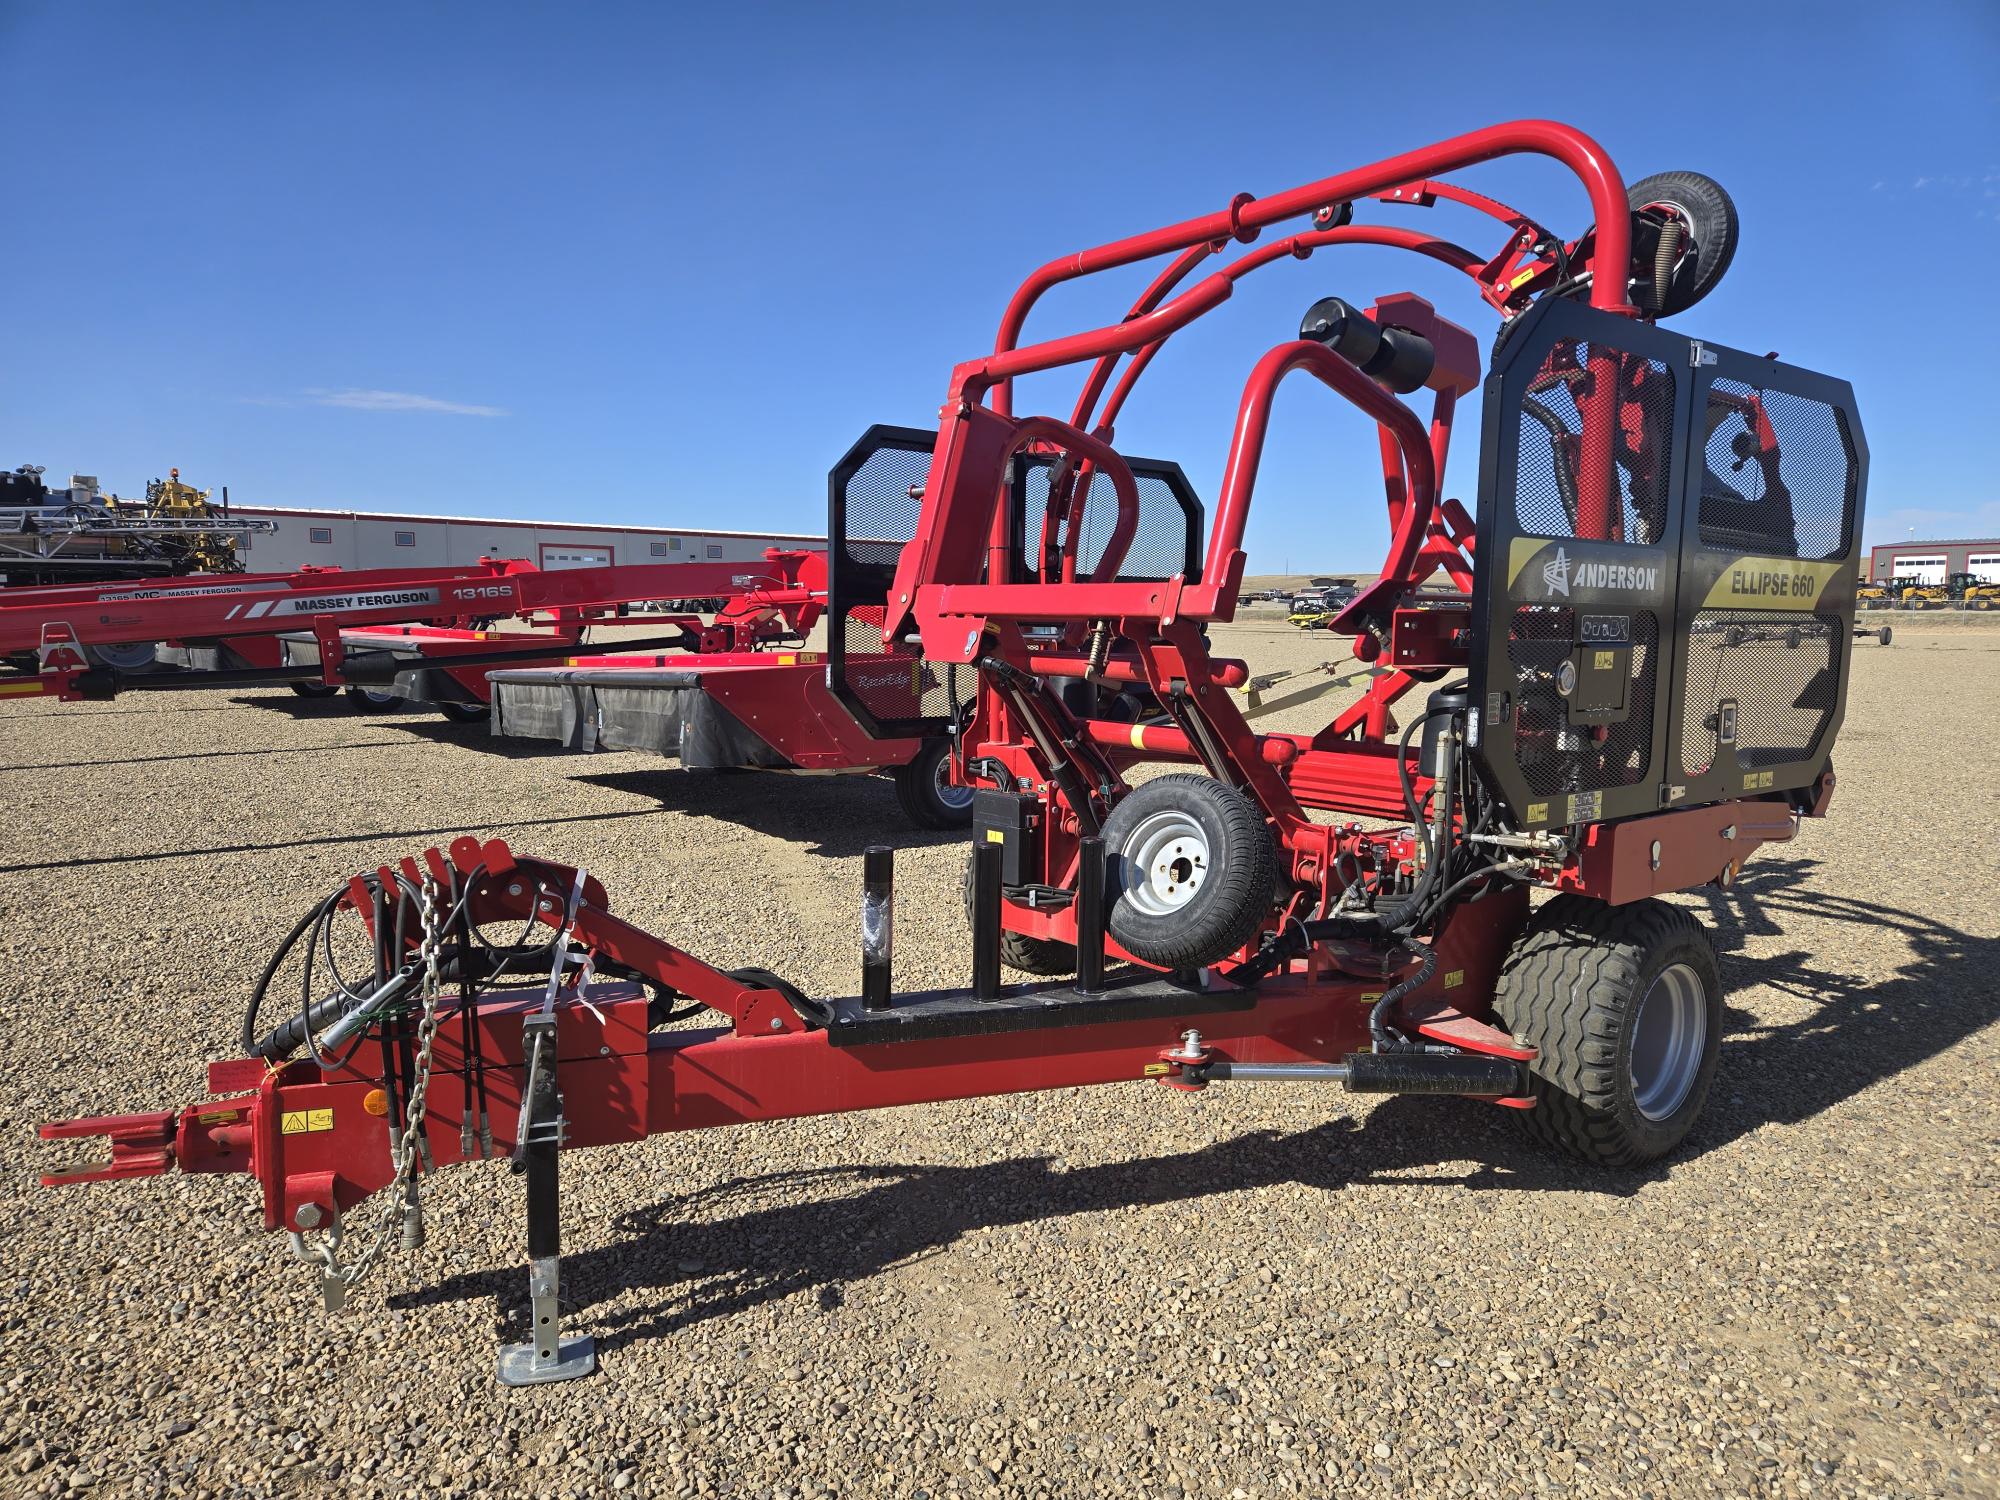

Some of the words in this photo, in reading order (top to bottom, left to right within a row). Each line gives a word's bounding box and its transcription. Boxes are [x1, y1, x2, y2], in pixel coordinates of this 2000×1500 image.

[1572, 563, 1656, 591] ANDERSON
[1731, 570, 1789, 596] ELLIPSE
[1791, 574, 1815, 598] 660
[134, 591, 160, 600] MC
[168, 589, 200, 598] MASSEY
[201, 586, 242, 595] FERGUSON
[452, 585, 513, 600] 1316S
[294, 597, 354, 611] MASSEY
[357, 591, 430, 607] FERGUSON
